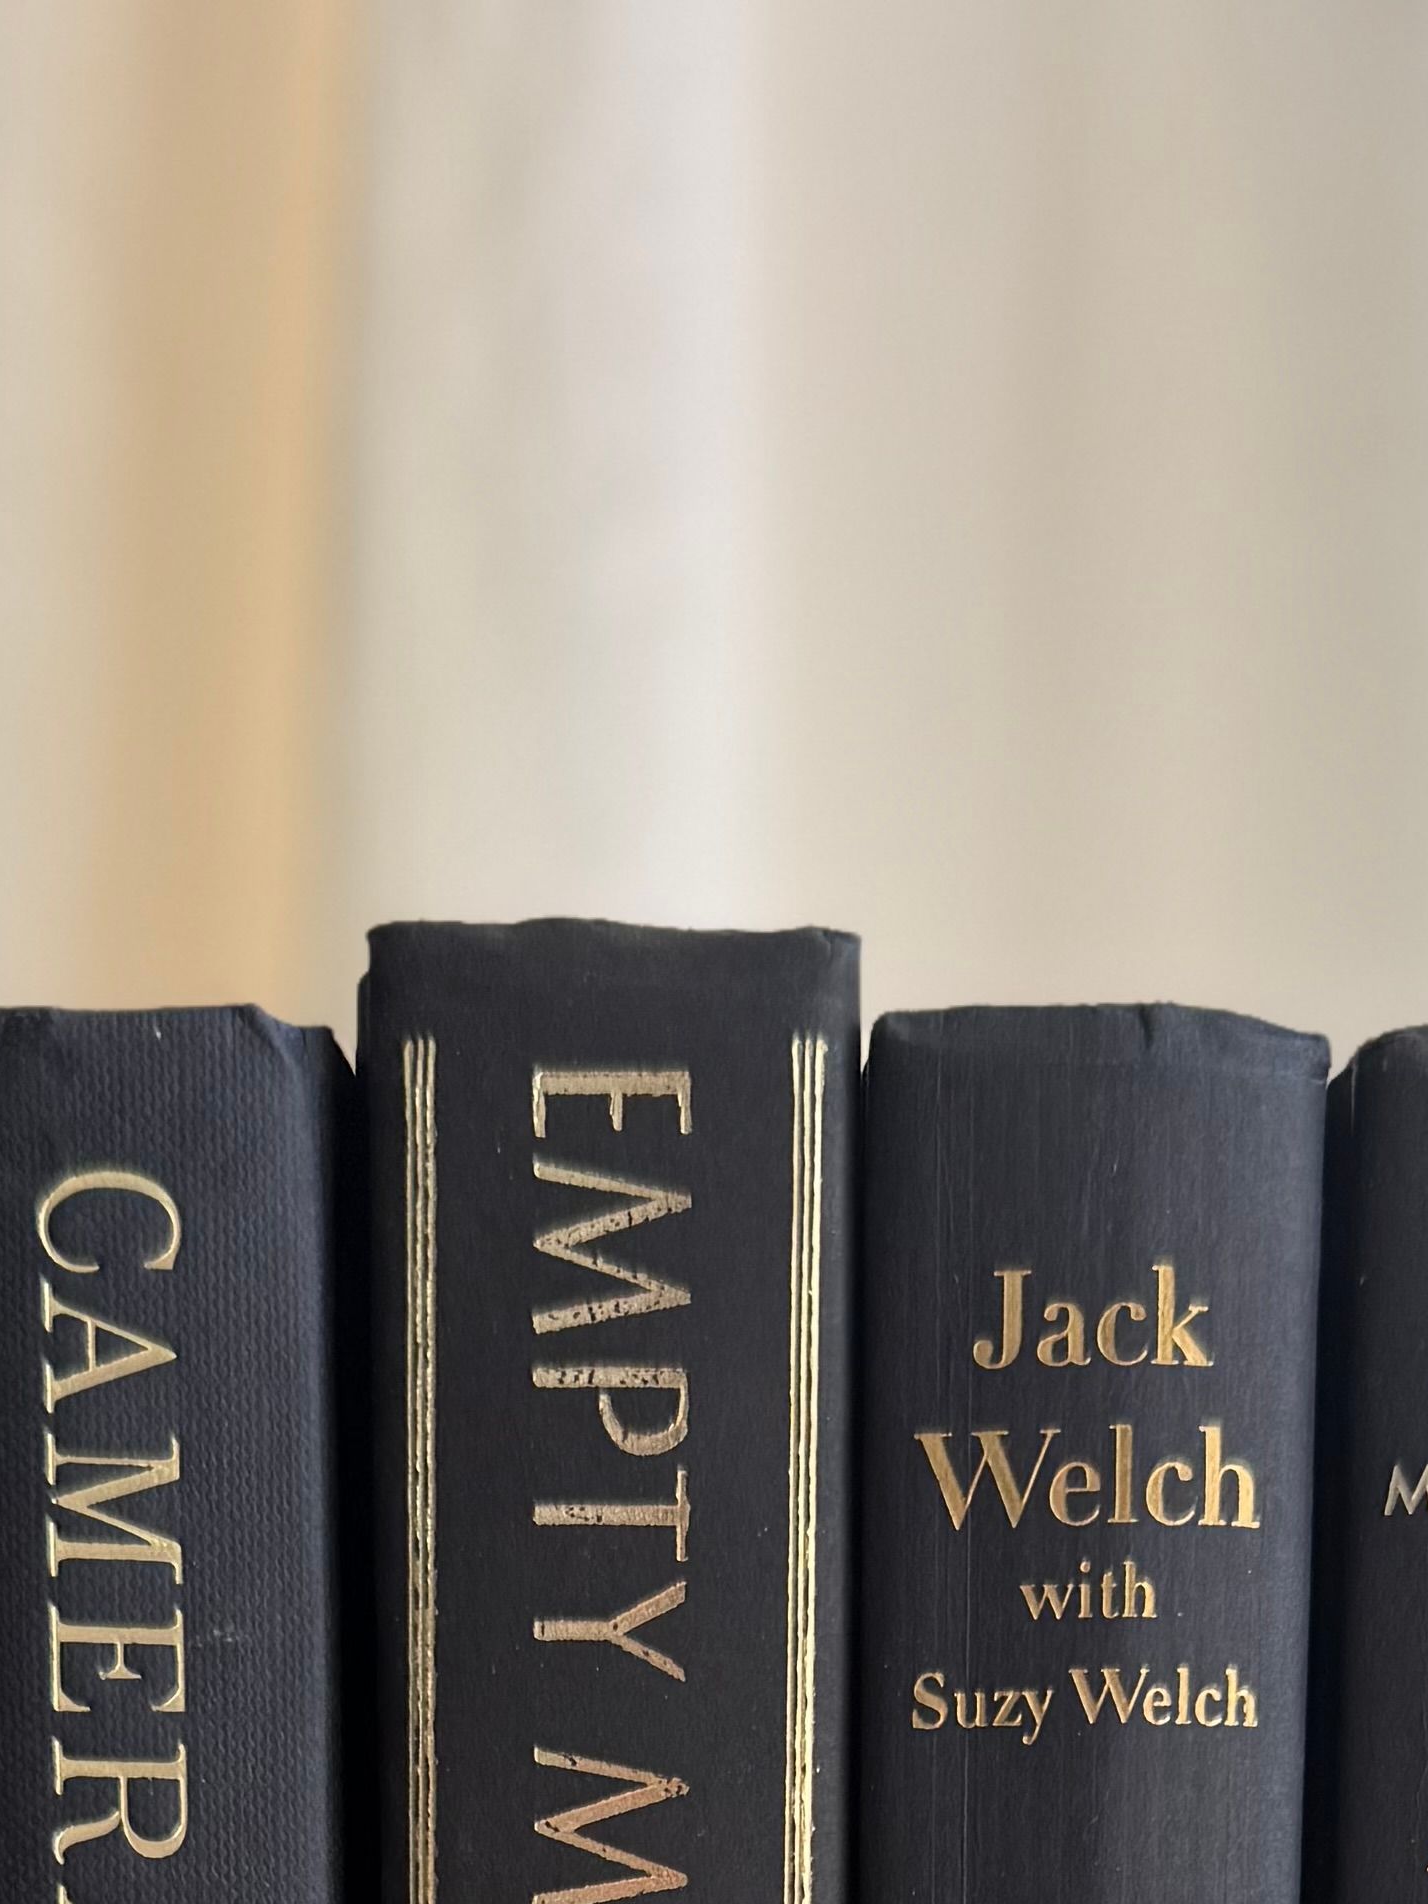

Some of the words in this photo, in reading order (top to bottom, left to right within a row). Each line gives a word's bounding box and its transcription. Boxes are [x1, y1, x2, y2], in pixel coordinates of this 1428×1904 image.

[972, 1262, 1215, 1369] Jack
[531, 1065, 693, 1682] EMPTY
[920, 1422, 1261, 1531] Welch
[1019, 1559, 1158, 1620] with
[912, 1671, 1053, 1745] Suzy
[1068, 1663, 1259, 1728] Welch
